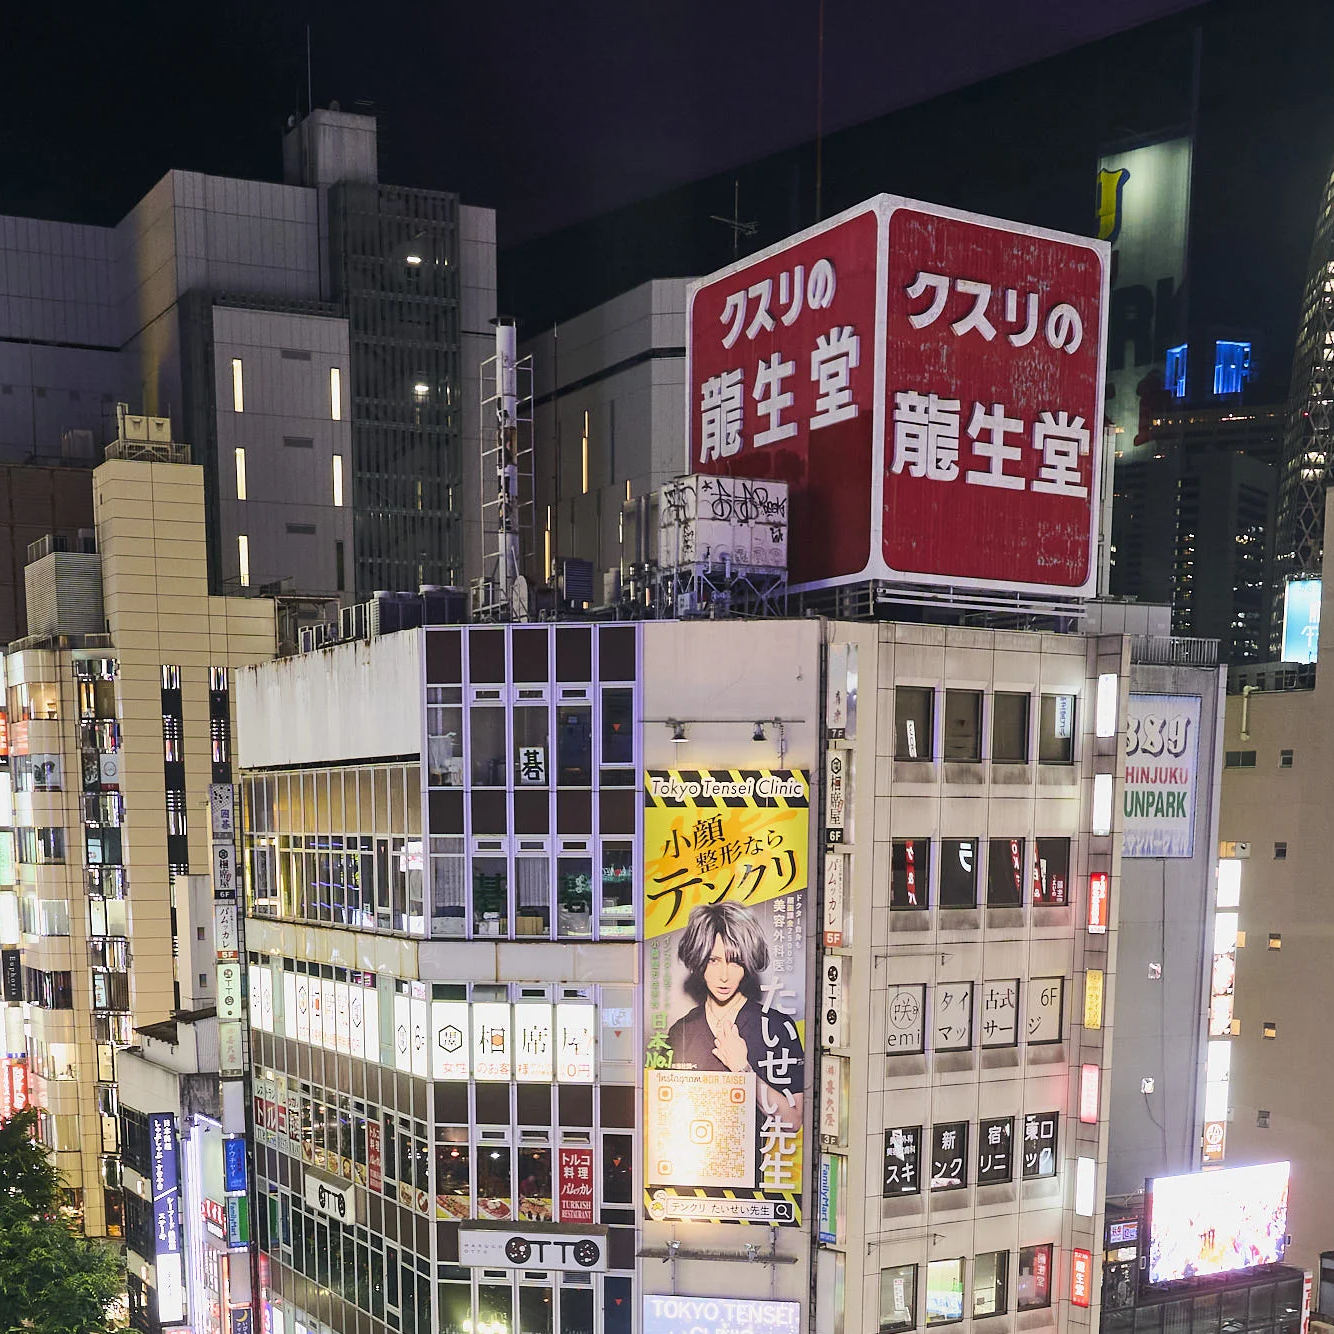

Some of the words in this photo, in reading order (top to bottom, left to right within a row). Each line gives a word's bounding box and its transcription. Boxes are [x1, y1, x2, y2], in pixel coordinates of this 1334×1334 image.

[720, 257, 837, 350] クスリの
[905, 271, 1084, 355] クスリの
[699, 325, 862, 465] 龍生堂
[891, 391, 1091, 499] 龍生堂
[521, 750, 544, 780] 碁
[651, 778, 698, 800] Tokyo
[704, 780, 753, 797] Tensei
[758, 778, 803, 797] Clinic
[663, 813, 726, 859] 小顔
[829, 830, 842, 842] 6F
[695, 829, 785, 876] 整形なら
[647, 849, 797, 928] テンクリ
[772, 899, 786, 973] 美容外科医
[826, 934, 840, 944] 5F
[221, 951, 234, 959] 5F
[940, 988, 1016, 1012] タイ古式
[1040, 987, 1058, 1007] 6F
[646, 1012, 672, 1051] 日本
[887, 1028, 921, 1047] emi
[938, 1016, 1042, 1041] マッサージ
[644, 1050, 674, 1070] No.1
[655, 1073, 703, 1085] Instagram
[721, 1075, 746, 1085] TAISEI
[757, 977, 799, 1190] たいせい先生
[824, 1134, 837, 1145] 3F
[941, 1120, 1054, 1151] 新宿東口
[561, 1153, 591, 1166] トルコ
[563, 1166, 590, 1180] 料理
[561, 1184, 593, 1197] パムッカレ
[820, 1163, 830, 1223] FamilyMart
[561, 1209, 592, 1221] RESTAURANT
[562, 1200, 592, 1211] TURKISH
[670, 1203, 706, 1213] テンクリ
[710, 1204, 771, 1217] たいせい先生
[228, 1201, 238, 1237] FamilyMart
[652, 1300, 719, 1321] TOKYO
[724, 1303, 795, 1325] TENSEI
